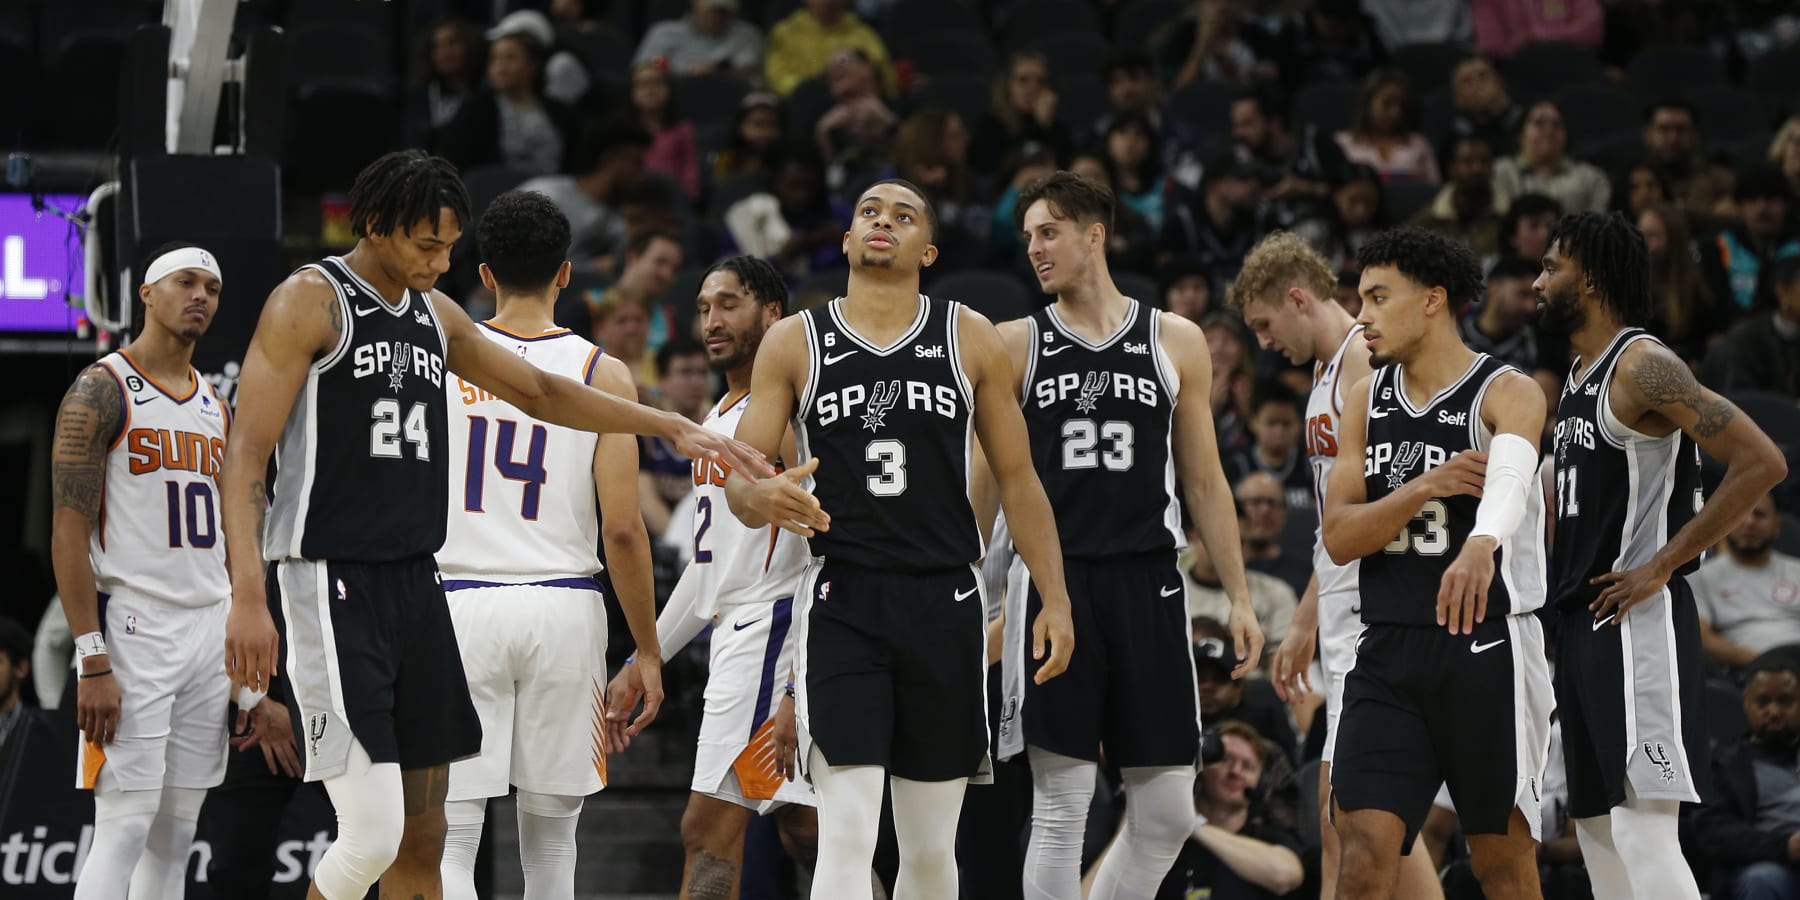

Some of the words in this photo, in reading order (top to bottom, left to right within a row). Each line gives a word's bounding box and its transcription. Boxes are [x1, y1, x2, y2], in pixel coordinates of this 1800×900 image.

[343, 283, 356, 297] 6
[414, 310, 433, 327] Self.
[824, 332, 836, 347] 6
[1043, 332, 1054, 342] 6
[353, 341, 443, 393] SPURS
[915, 345, 945, 358] Self.
[1123, 342, 1150, 355] Self.
[128, 377, 142, 391] 6
[816, 380, 957, 433] SPURS
[1036, 371, 1157, 414] SPURS
[1381, 387, 1393, 400] 6
[370, 398, 430, 461] 24
[1437, 409, 1467, 426] Self.
[128, 428, 226, 480] SUNS
[464, 415, 548, 521] 14
[865, 439, 907, 497] 3
[1061, 418, 1135, 472] 23
[1365, 441, 1460, 489] SPUR
[165, 480, 216, 549] 10
[1557, 465, 1579, 520] 31
[695, 495, 713, 563] 2
